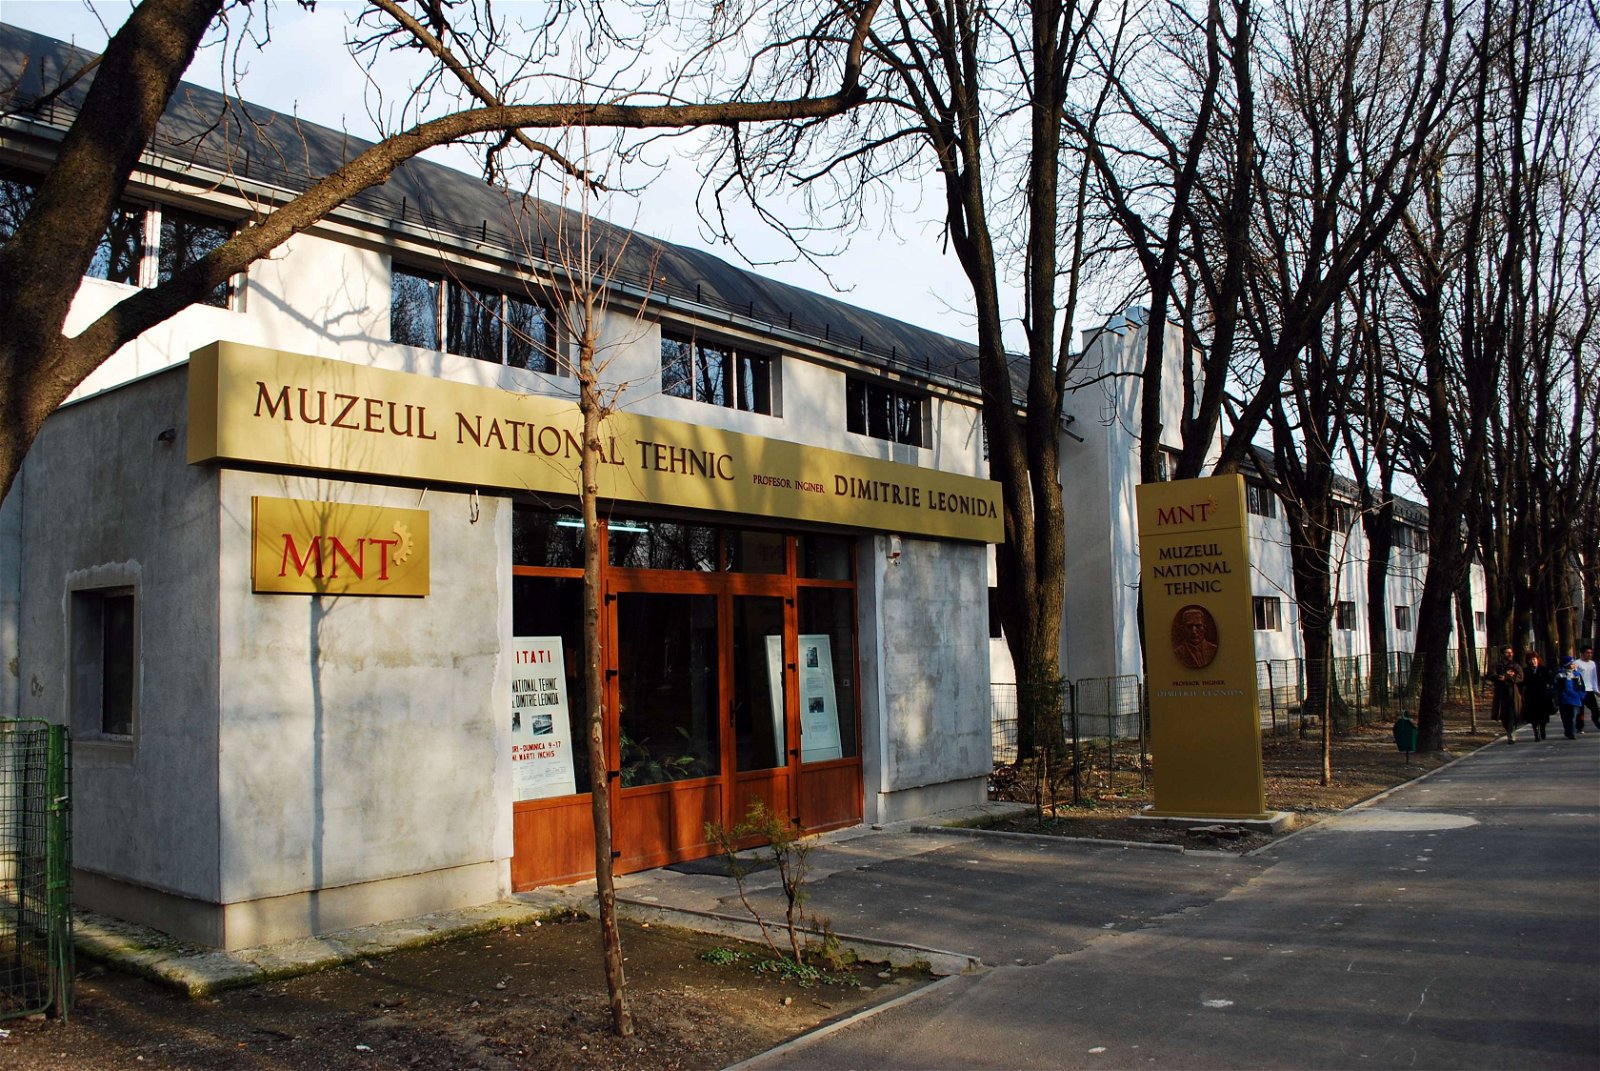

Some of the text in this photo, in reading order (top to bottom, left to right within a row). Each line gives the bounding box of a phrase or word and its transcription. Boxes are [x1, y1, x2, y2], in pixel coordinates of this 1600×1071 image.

[254, 381, 437, 440] MUZEUL
[635, 438, 736, 481] TEHNIC
[753, 474, 792, 489] PROFESOR
[795, 480, 825, 494] INGINER
[834, 474, 921, 508] DIMITRIE
[928, 490, 998, 519] LEONIDA
[1157, 503, 1210, 526] MNT
[278, 533, 399, 581] MNT
[1159, 543, 1223, 561] MUZEUL
[1152, 560, 1232, 579] NATIONAL
[1164, 579, 1223, 596] TEHNIC
